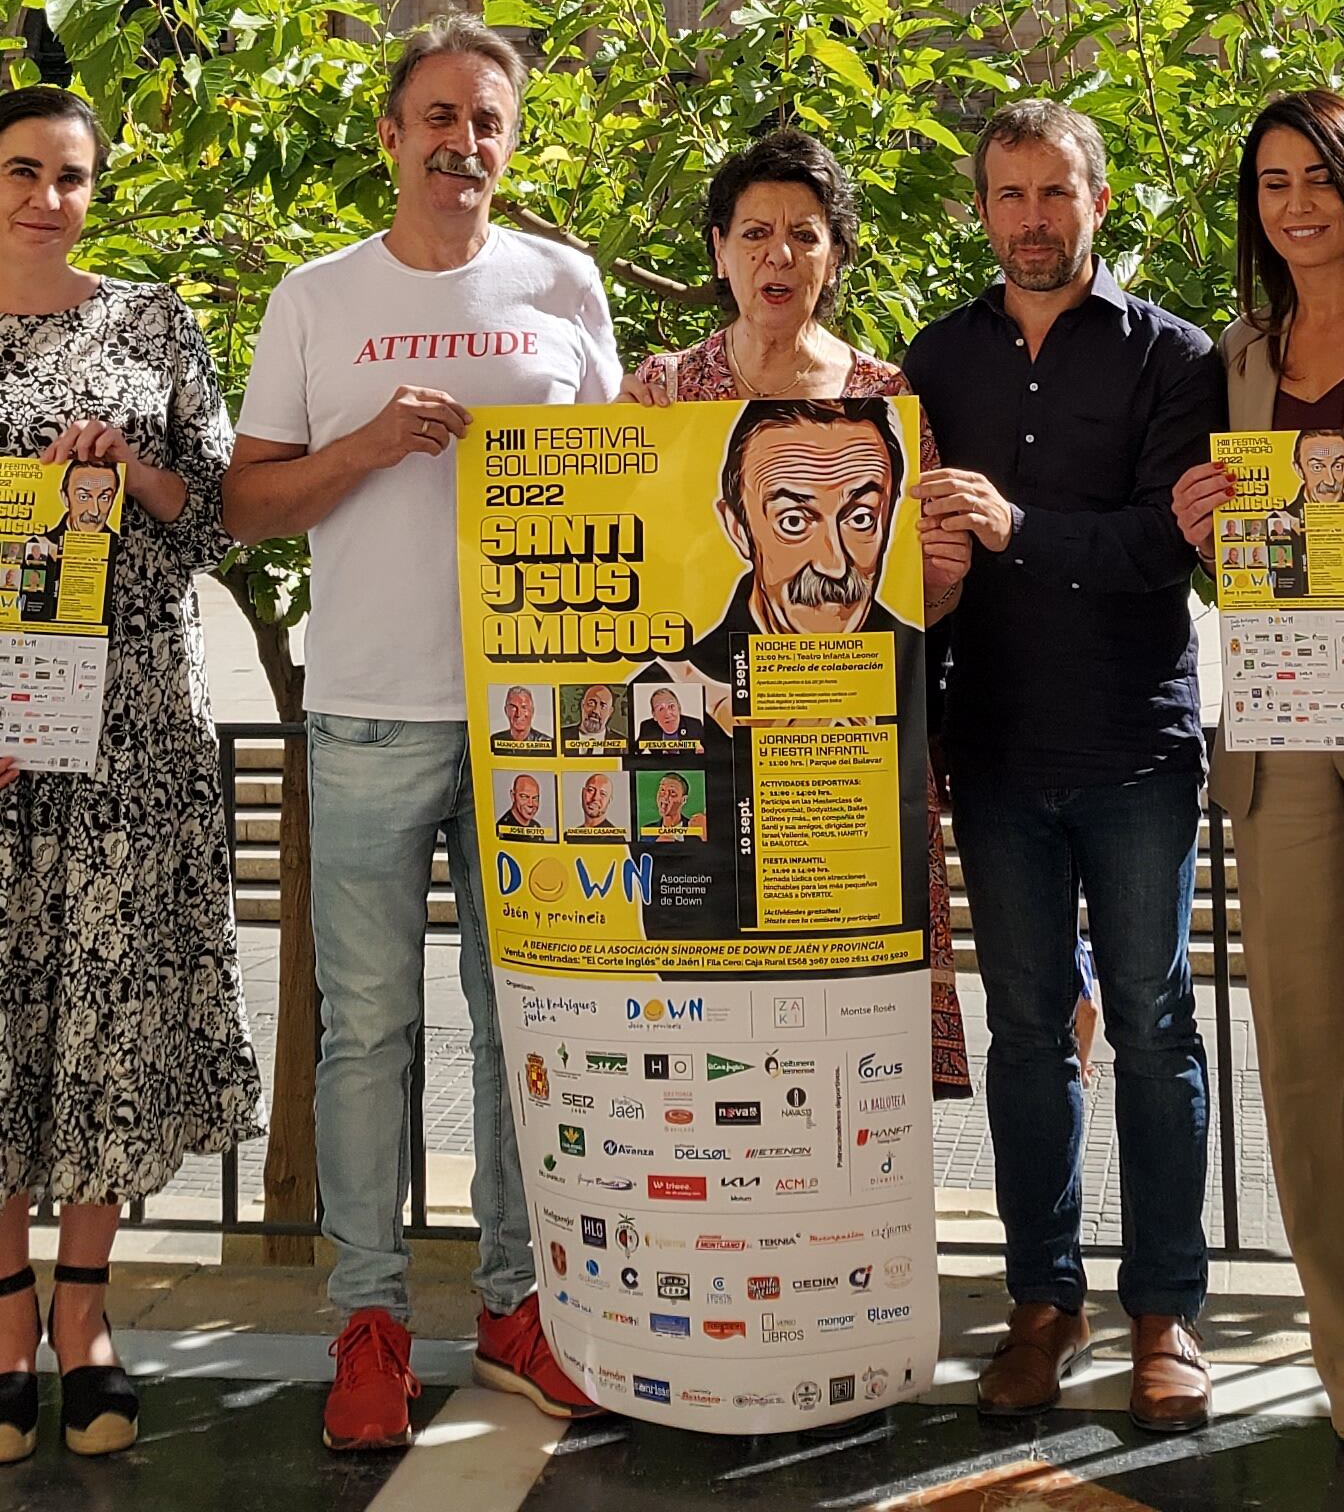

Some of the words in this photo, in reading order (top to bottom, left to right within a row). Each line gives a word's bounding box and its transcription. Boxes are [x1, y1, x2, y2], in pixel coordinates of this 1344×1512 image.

[353, 331, 538, 364] ATTITUDE
[486, 429, 525, 451] XIII
[534, 426, 655, 450] FESTIVAL
[1231, 438, 1272, 446] FESTIVAL
[486, 453, 657, 477] SOLIDARIDAD
[486, 484, 564, 506] 2022
[481, 514, 643, 561] SANTI
[525, 562, 639, 610] SUS
[483, 612, 692, 661] AMIGOS
[756, 642, 796, 651] NOCHE
[800, 641, 816, 651] DE
[819, 640, 863, 650] HUMOR
[756, 664, 774, 672] 22€
[777, 664, 806, 672] Precio
[808, 663, 819, 671] de
[821, 662, 883, 671] colaboración
[759, 735, 817, 745] JORNADA
[821, 732, 888, 743] DEPORTIVA
[771, 747, 812, 756] FIESTA
[816, 746, 869, 755] INFANTIL
[810, 759, 837, 767] Parque
[497, 851, 653, 905] DOWN
[660, 874, 712, 883] Asociación
[660, 897, 673, 906] de
[675, 897, 703, 906] Down
[548, 909, 606, 928] provincia
[531, 941, 577, 952] BENEFICIO
[579, 945, 592, 954] DE
[594, 946, 606, 954] LA
[608, 944, 669, 954] ASOCIACIÓN
[671, 944, 725, 955] SÍNDROME
[727, 946, 740, 955] DE
[743, 945, 776, 955] DOWN
[778, 945, 792, 954] DE
[794, 942, 820, 954] JAÉN
[822, 944, 828, 953] Y
[830, 940, 885, 952] PROVINCIA
[504, 947, 526, 958] Venta
[527, 952, 538, 960] de
[539, 954, 581, 964] entradas:
[598, 957, 624, 966] Corte
[662, 958, 674, 966] de
[676, 957, 700, 966] Jaén
[745, 958, 763, 967] Caja
[626, 997, 704, 1022] DOWN
[840, 1007, 872, 1016] Montse
[873, 1003, 896, 1013] Rosés
[562, 1093, 595, 1109] SER
[618, 1144, 654, 1156] Avanza
[721, 1177, 761, 1187] KIA
[776, 1179, 805, 1190] ACM
[759, 1237, 796, 1247] TEKNIA
[867, 1305, 910, 1322] Blaveo
[762, 1330, 804, 1343] LIBROS
